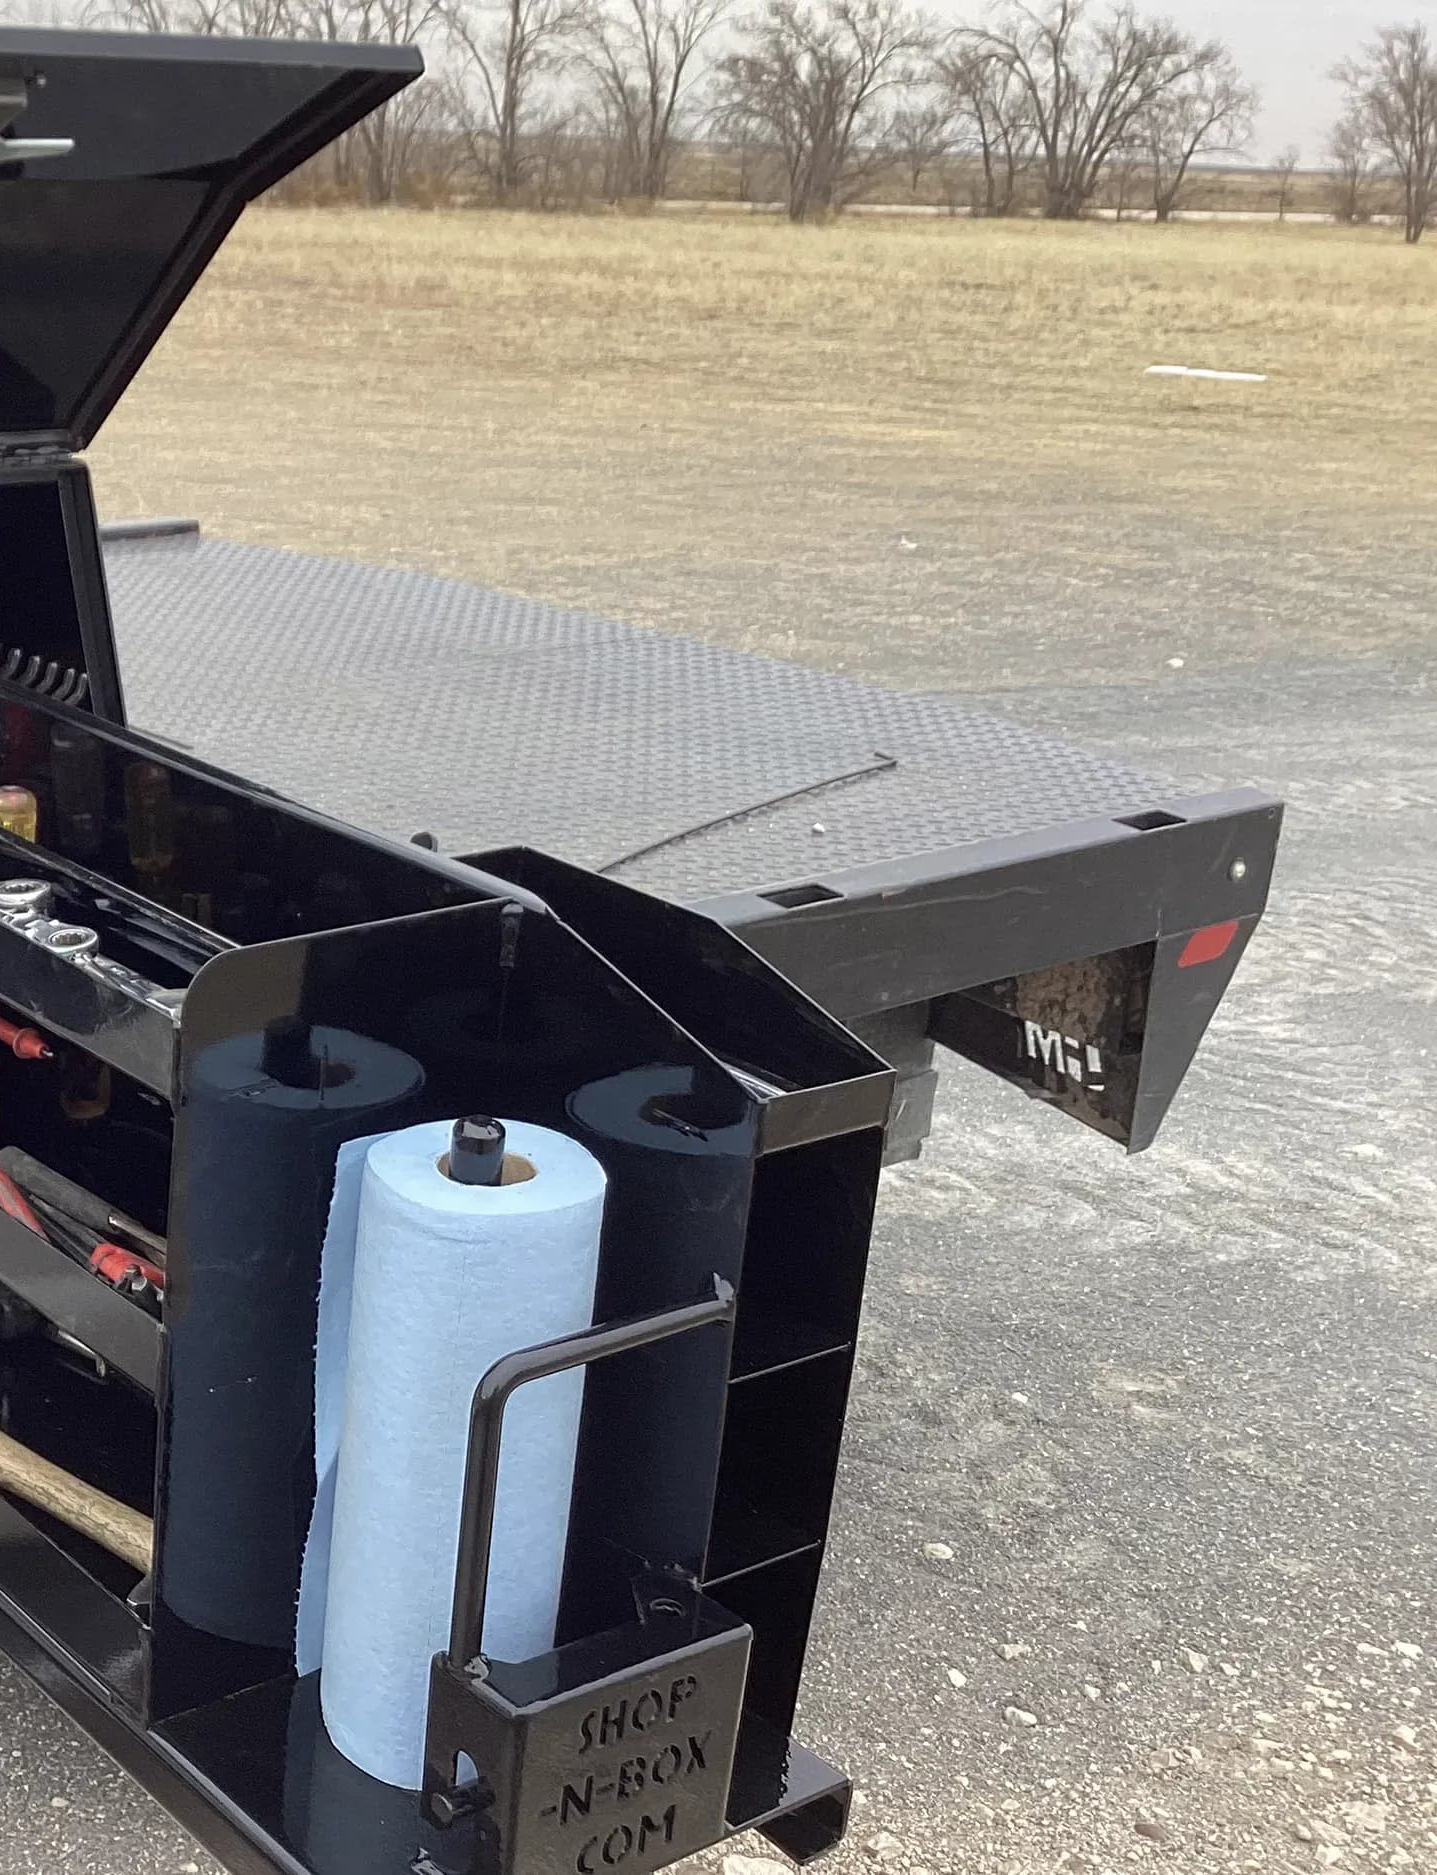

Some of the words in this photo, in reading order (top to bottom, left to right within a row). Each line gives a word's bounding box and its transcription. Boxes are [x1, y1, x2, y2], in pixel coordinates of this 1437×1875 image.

[578, 1675, 697, 1755] SHOP
[539, 1730, 712, 1827] -N-BOX
[576, 1803, 676, 1875] COM
